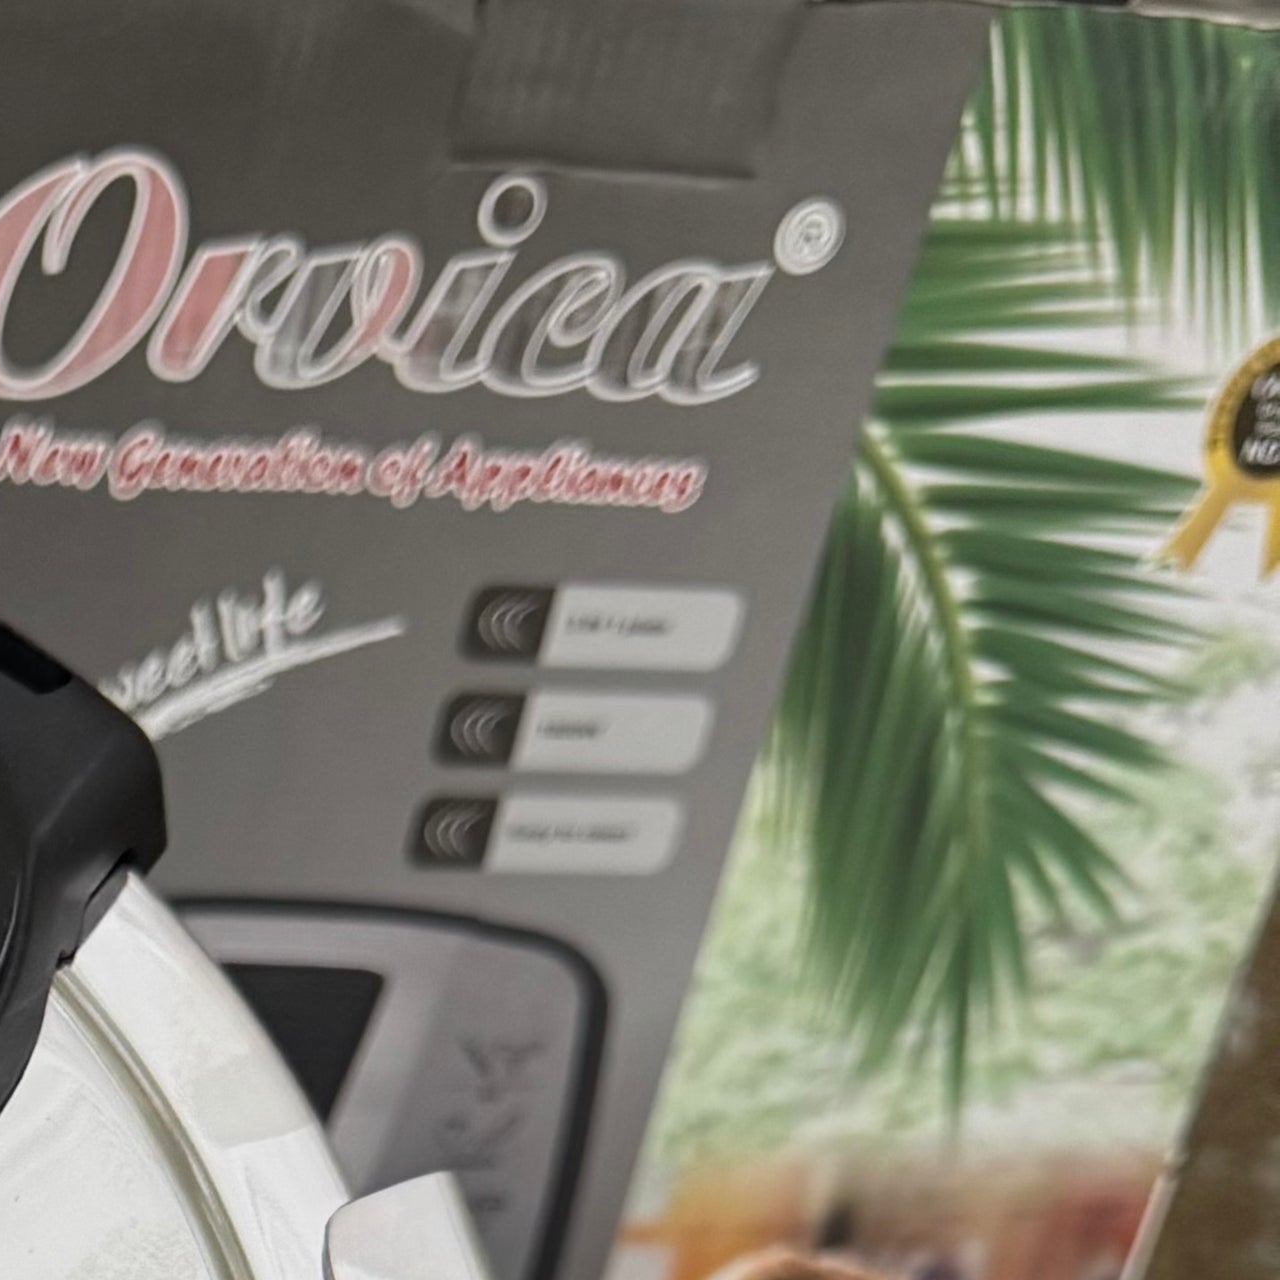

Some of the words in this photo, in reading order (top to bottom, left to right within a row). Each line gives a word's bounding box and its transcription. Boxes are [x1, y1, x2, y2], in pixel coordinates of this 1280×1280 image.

[107, 418, 366, 502] Generation
[366, 430, 441, 508] of
[426, 437, 708, 514] Appliances
